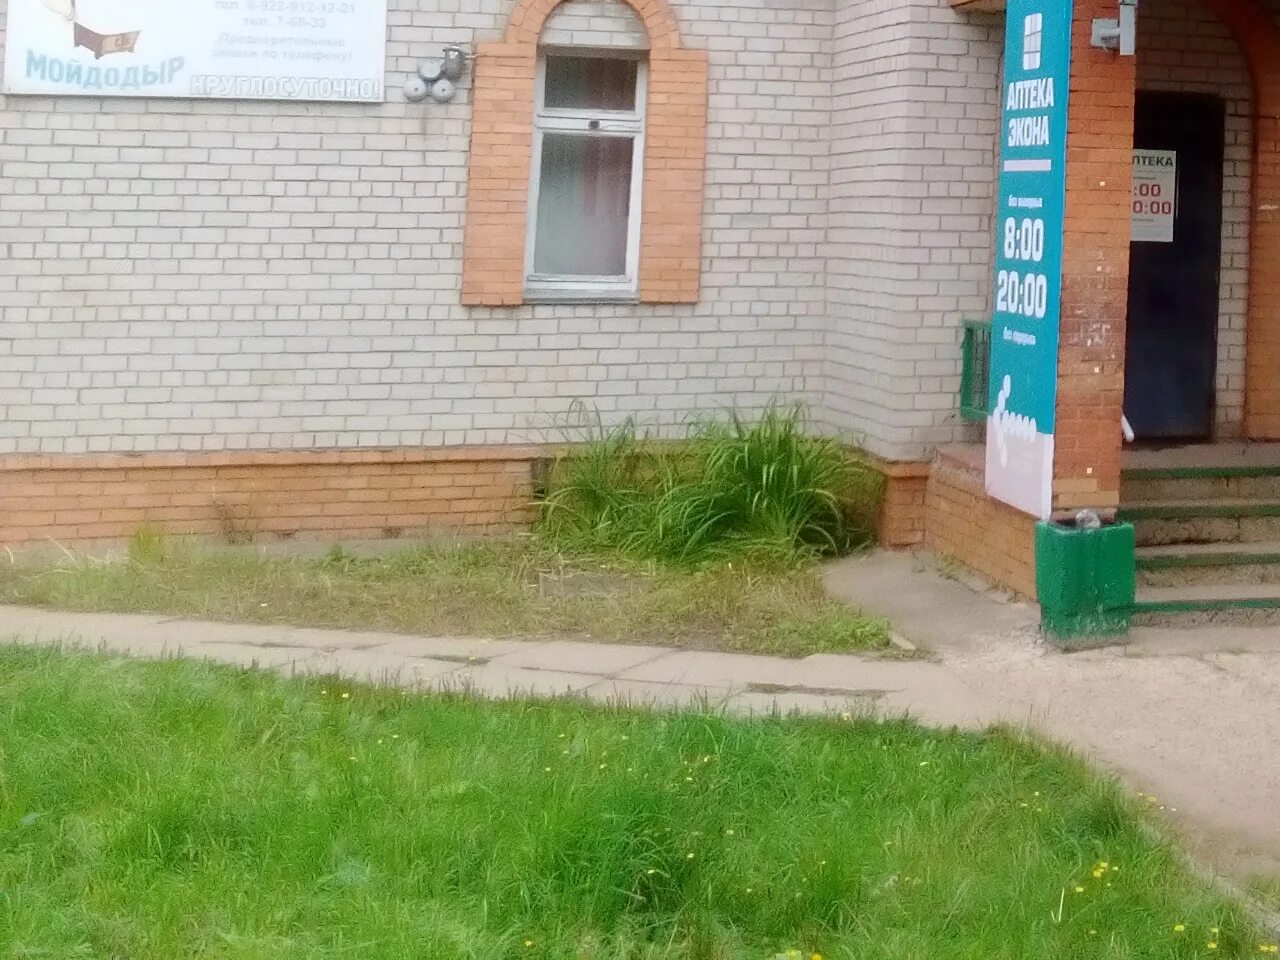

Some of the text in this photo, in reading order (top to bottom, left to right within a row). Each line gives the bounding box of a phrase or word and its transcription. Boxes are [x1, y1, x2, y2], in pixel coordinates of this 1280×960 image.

[190, 74, 380, 100] КРУГЛОСУТОЧНО!
[1006, 77, 1055, 111] АПТЕКА
[1008, 115, 1050, 147] ЭКОНА
[1003, 217, 1044, 262] 8:00
[996, 270, 1048, 319] 20:00
